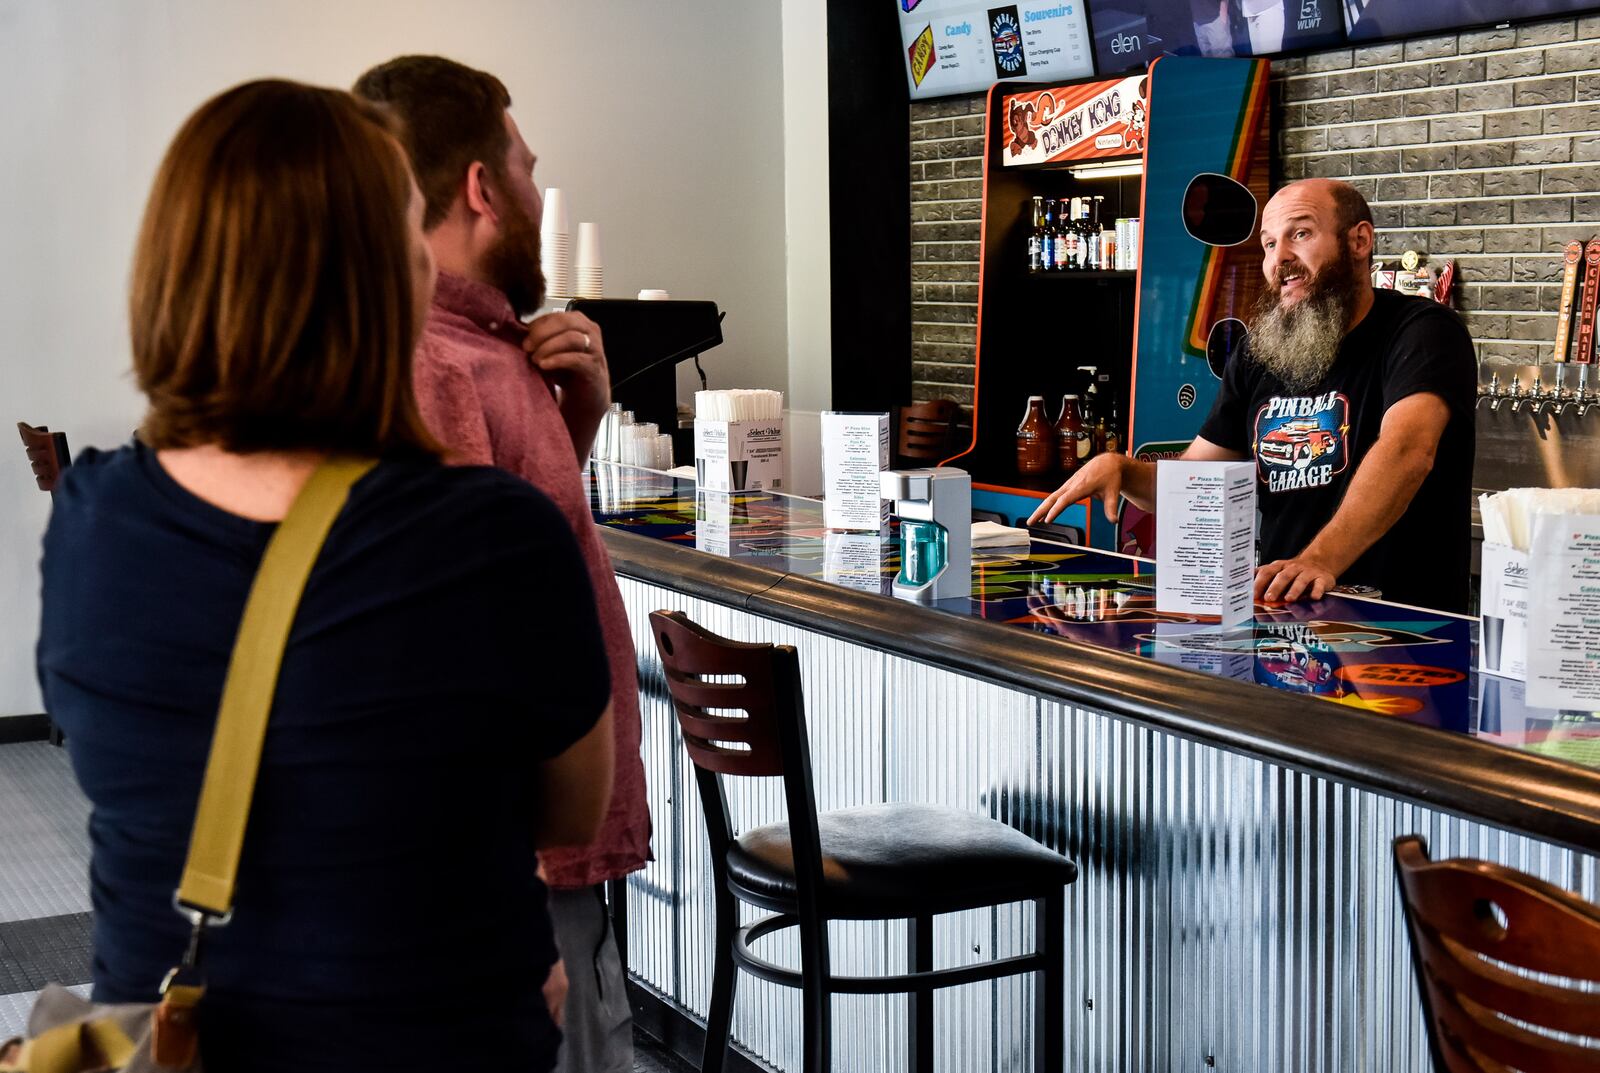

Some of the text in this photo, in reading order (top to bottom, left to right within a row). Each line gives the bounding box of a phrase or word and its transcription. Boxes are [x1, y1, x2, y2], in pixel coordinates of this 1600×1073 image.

[992, 13, 1018, 34] PINBALL
[1024, 4, 1072, 23] Souvenirs
[1298, 18, 1322, 30] WLWT
[945, 22, 972, 36] Candy
[1111, 32, 1141, 55] ellen
[912, 34, 932, 76] CANDY
[998, 53, 1022, 72] GARAGE
[1042, 90, 1121, 155] DONKEY KONG
[1584, 268, 1598, 318] COUGAR
[1580, 324, 1591, 359] BAIT
[1265, 391, 1336, 419] PINBALL
[747, 427, 781, 437] Select Value
[1269, 464, 1332, 492] GARAGE
[1358, 673, 1428, 683] BALL
[1362, 666, 1457, 678] EXTRA
